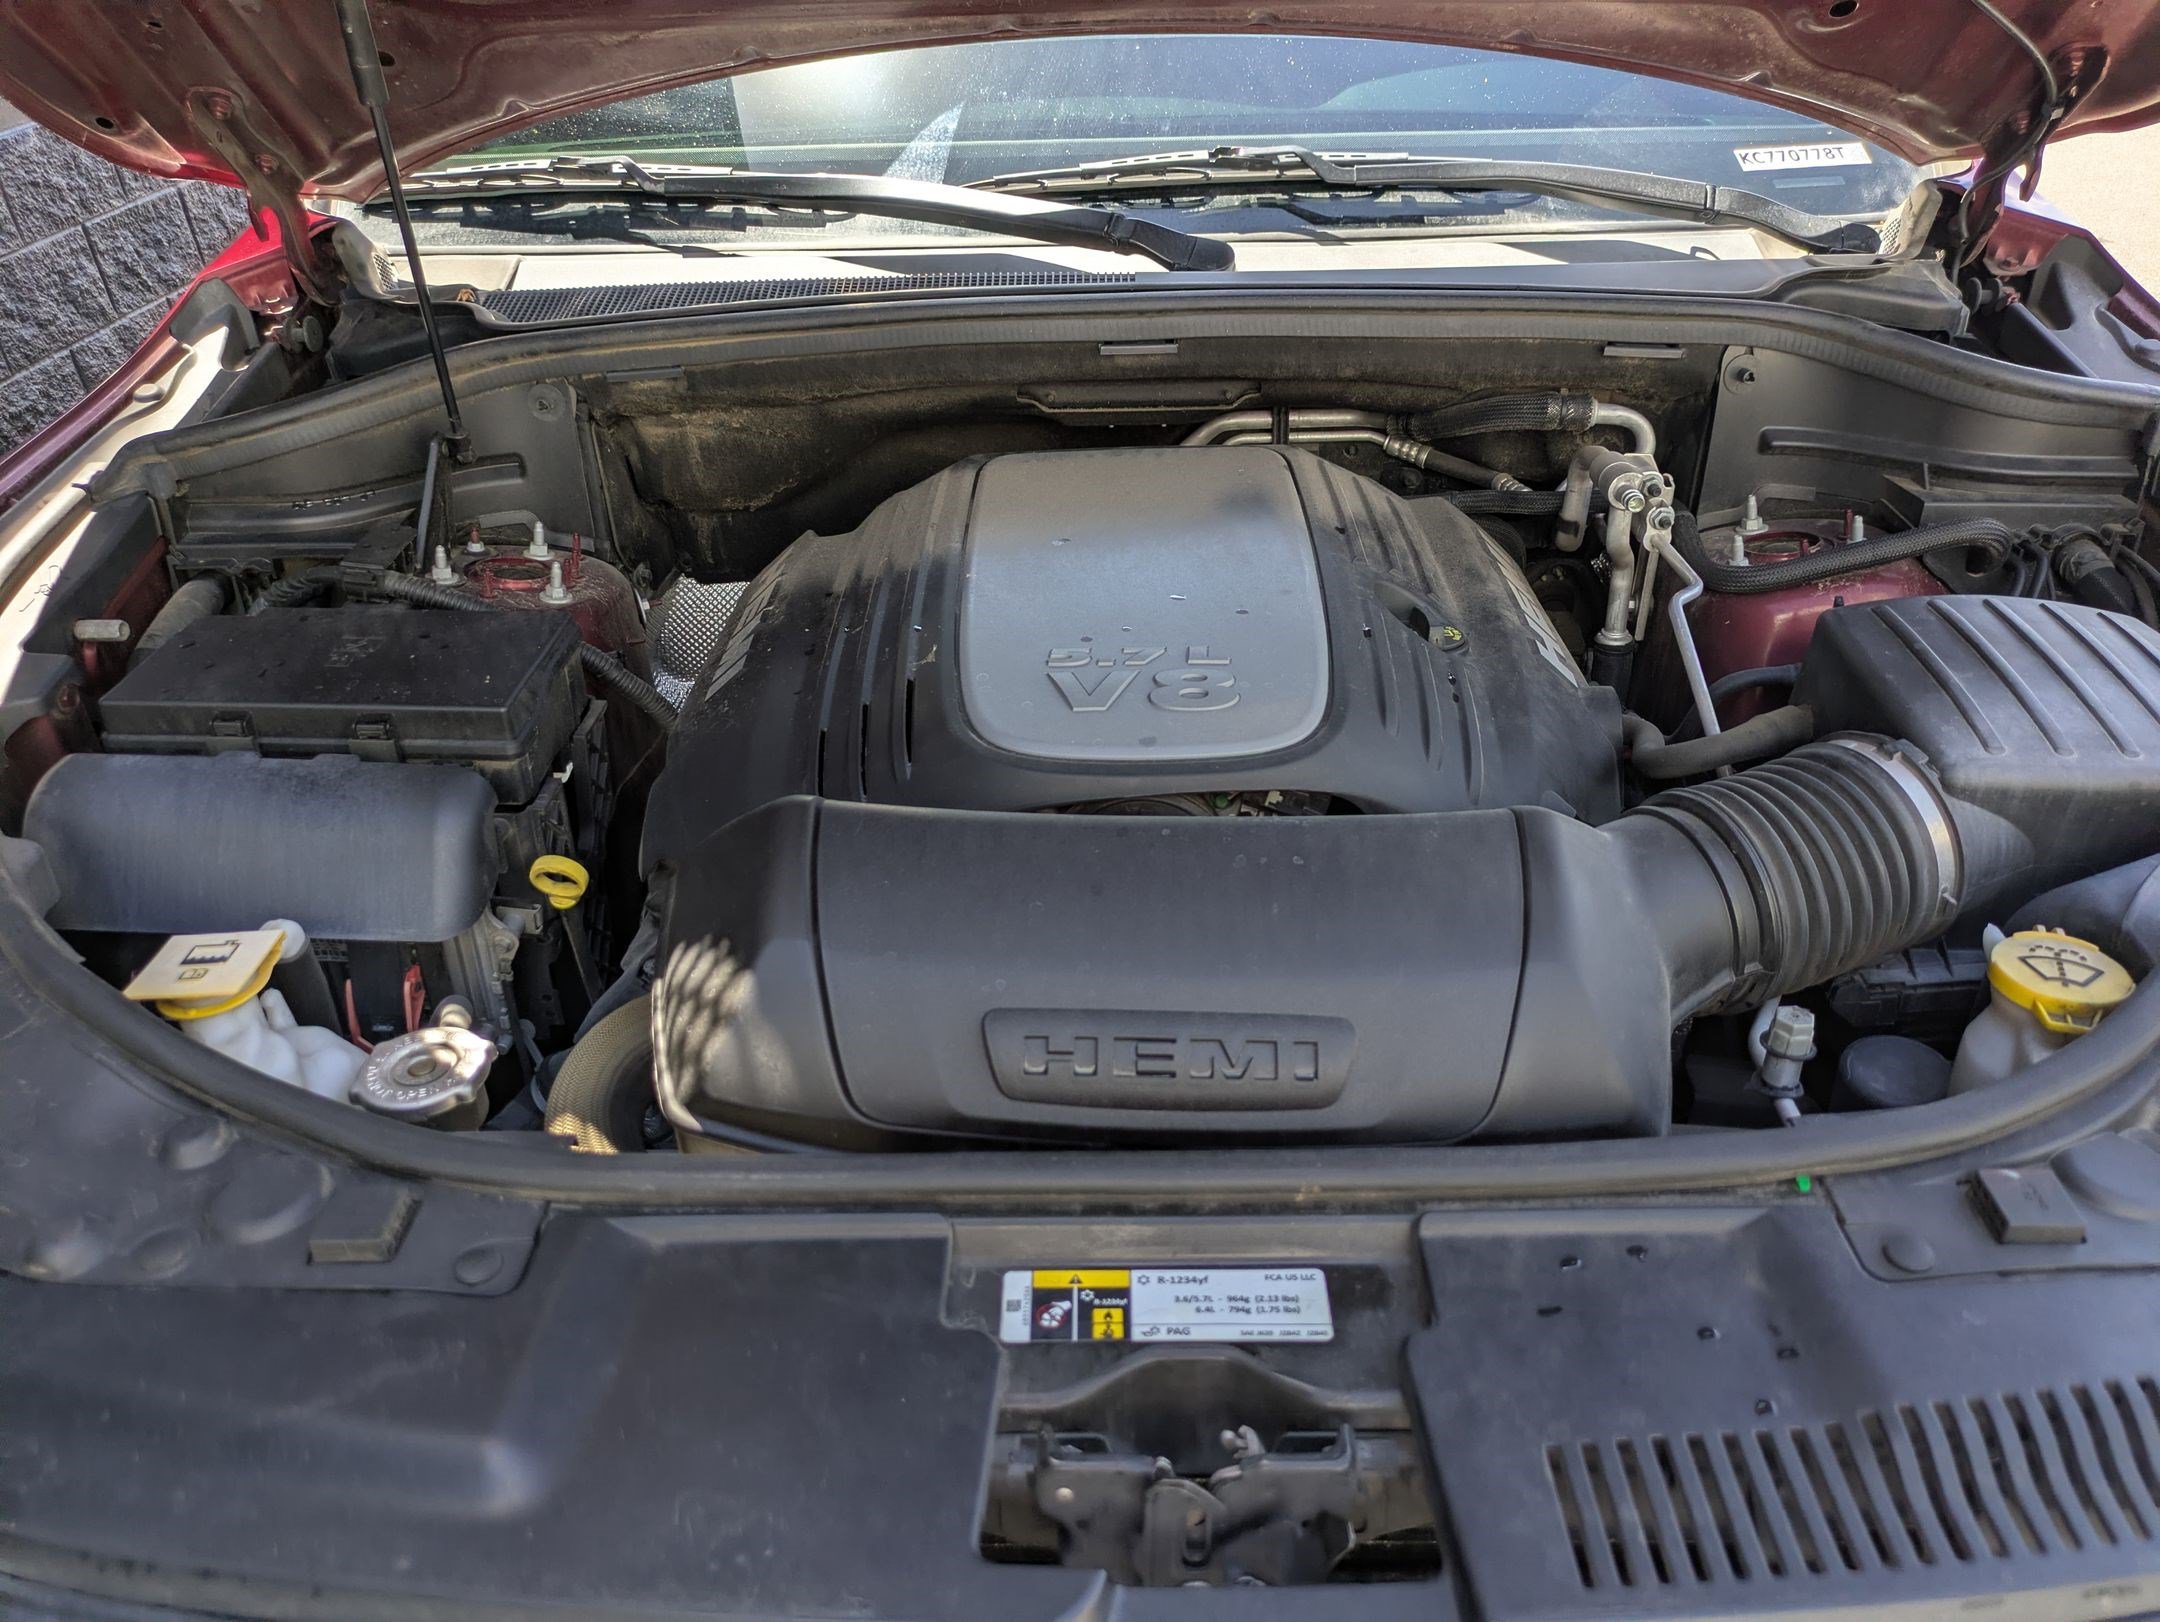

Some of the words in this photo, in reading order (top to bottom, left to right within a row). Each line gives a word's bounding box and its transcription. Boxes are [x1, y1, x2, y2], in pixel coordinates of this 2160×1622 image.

[1738, 147, 1844, 165] KC770778T
[1045, 669, 1241, 712] V8
[1023, 1035, 1319, 1081] HEMI
[1157, 1275, 1209, 1286] R-1234yf
[1264, 1273, 1282, 1281] FCA
[1284, 1273, 1298, 1281] US
[1300, 1273, 1317, 1281] LLC
[1166, 1327, 1191, 1336] PAG
